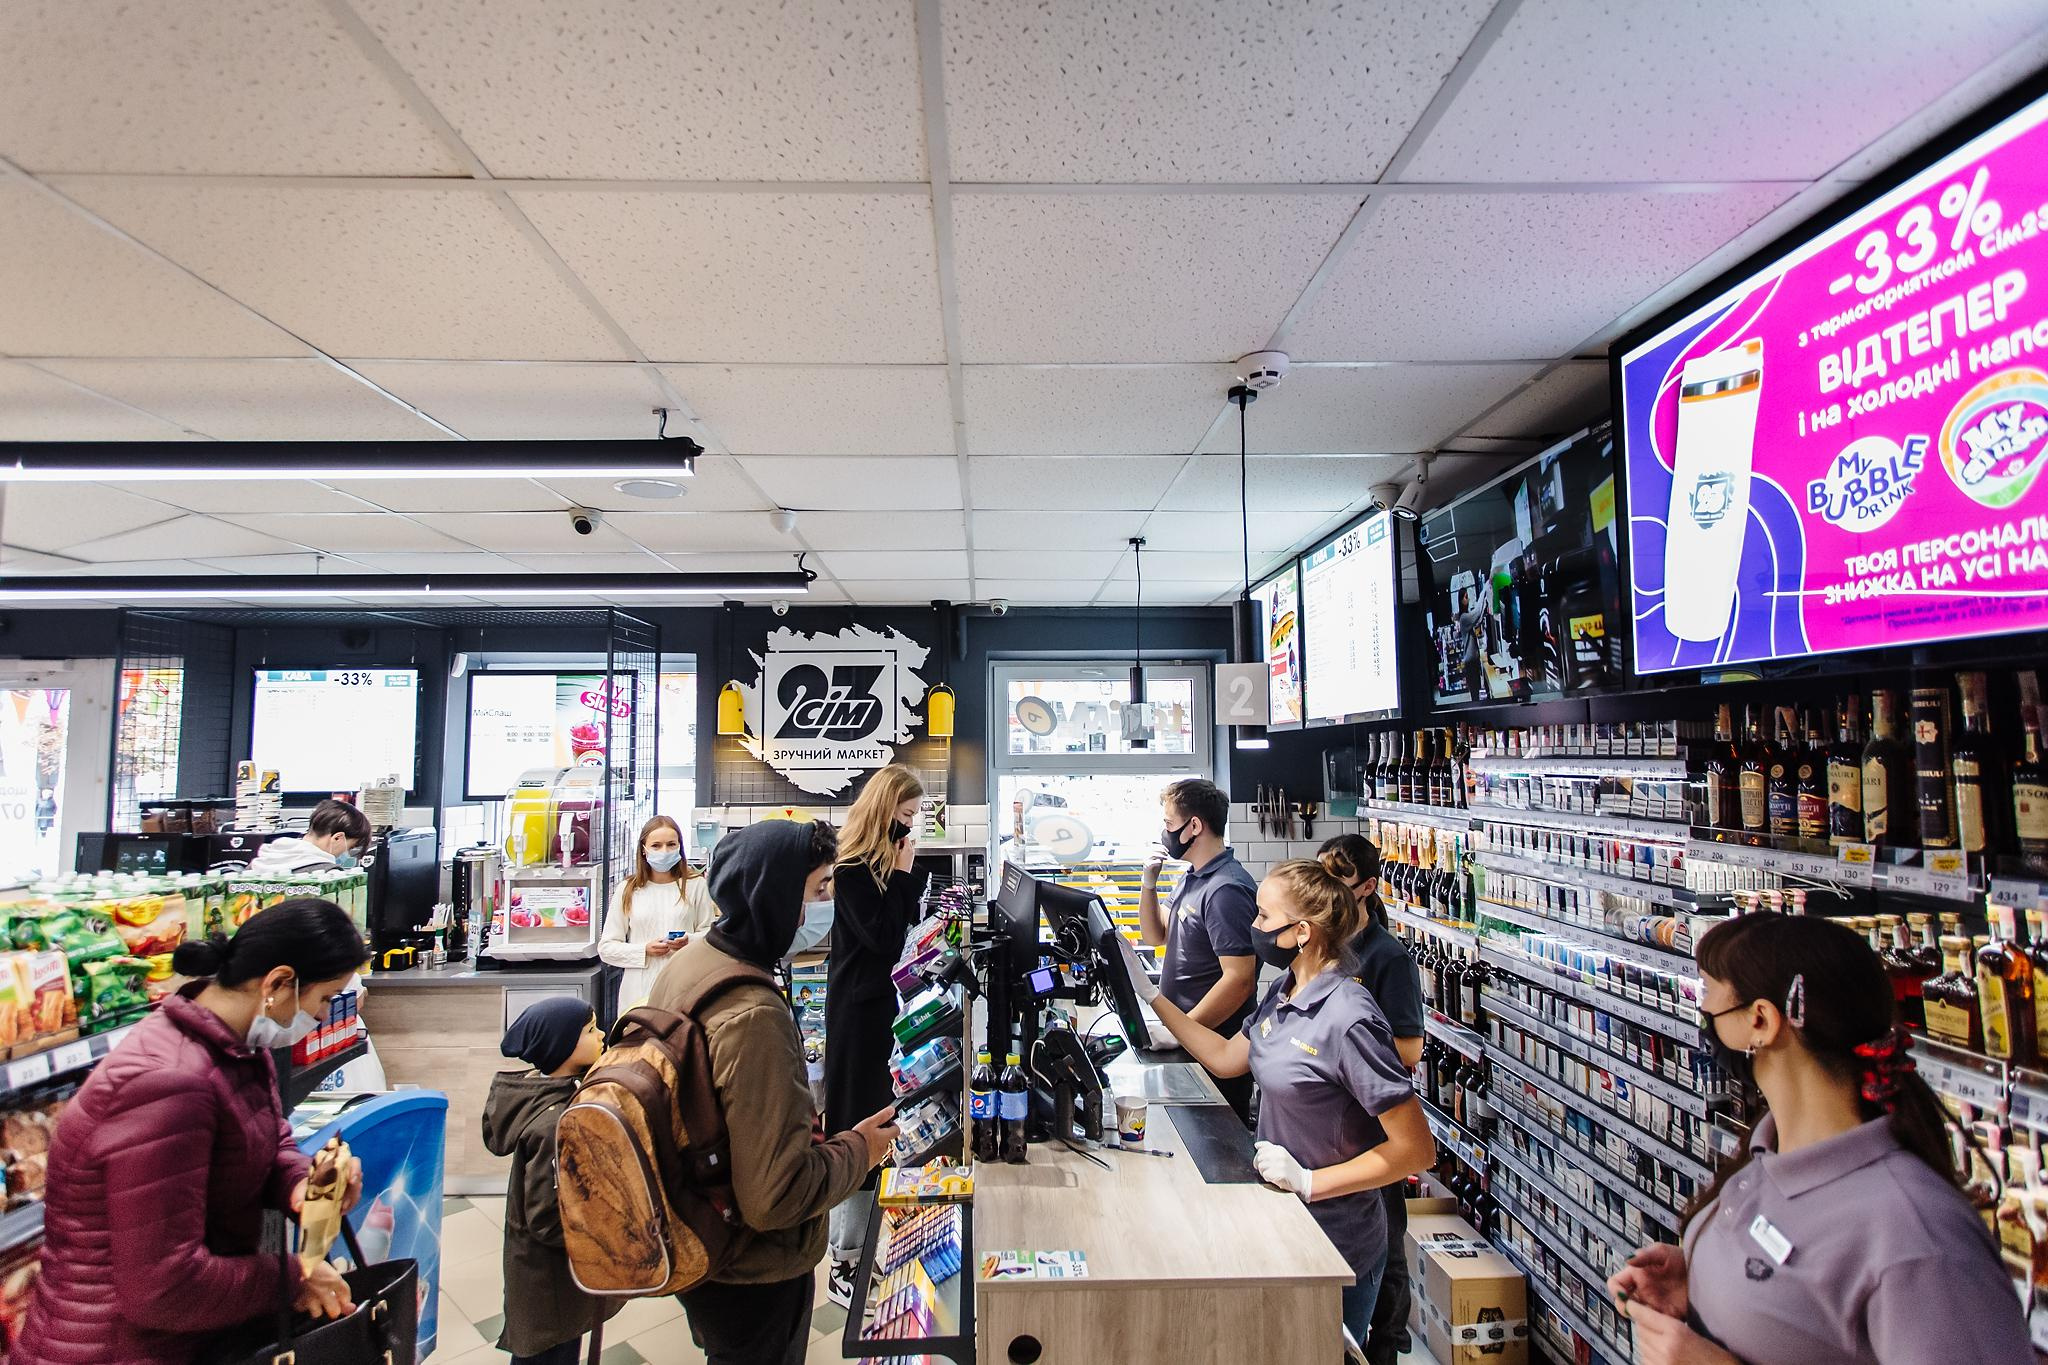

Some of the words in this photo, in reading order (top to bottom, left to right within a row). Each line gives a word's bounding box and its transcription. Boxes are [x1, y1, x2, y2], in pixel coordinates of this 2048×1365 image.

[1829, 165, 2003, 295] -33%
[1798, 333, 1808, 348] з
[1811, 250, 1976, 340] термогорнятком
[1818, 269, 2028, 394] ВІДТЕПЕР
[1798, 411, 1806, 437] і
[1812, 405, 1842, 432] на
[1848, 365, 1961, 419] холодні
[1809, 437, 1927, 520] BUBBLE
[1857, 484, 1915, 520] DRINK
[1338, 531, 1361, 558] -33%
[1823, 572, 1917, 605] ЗНИЖКА
[1921, 565, 1957, 589] НА
[1960, 553, 2002, 582] УСІ
[1844, 550, 1899, 577] ТВОЯ
[334, 673, 373, 686] -33%
[774, 664, 885, 741] 23
[1230, 676, 1255, 717] 2
[773, 748, 831, 760] ЗРУЧНИЙ
[836, 750, 885, 760] МАРКЕТ
[1711, 852, 1723, 860] 206
[1764, 859, 1775, 867] 164
[1791, 863, 1804, 872] 153
[1810, 865, 1823, 874] 157
[1844, 870, 1858, 879] 130
[1894, 875, 1910, 885] 195
[1933, 882, 1949, 892] 129
[1958, 1084, 1975, 1098] 184
